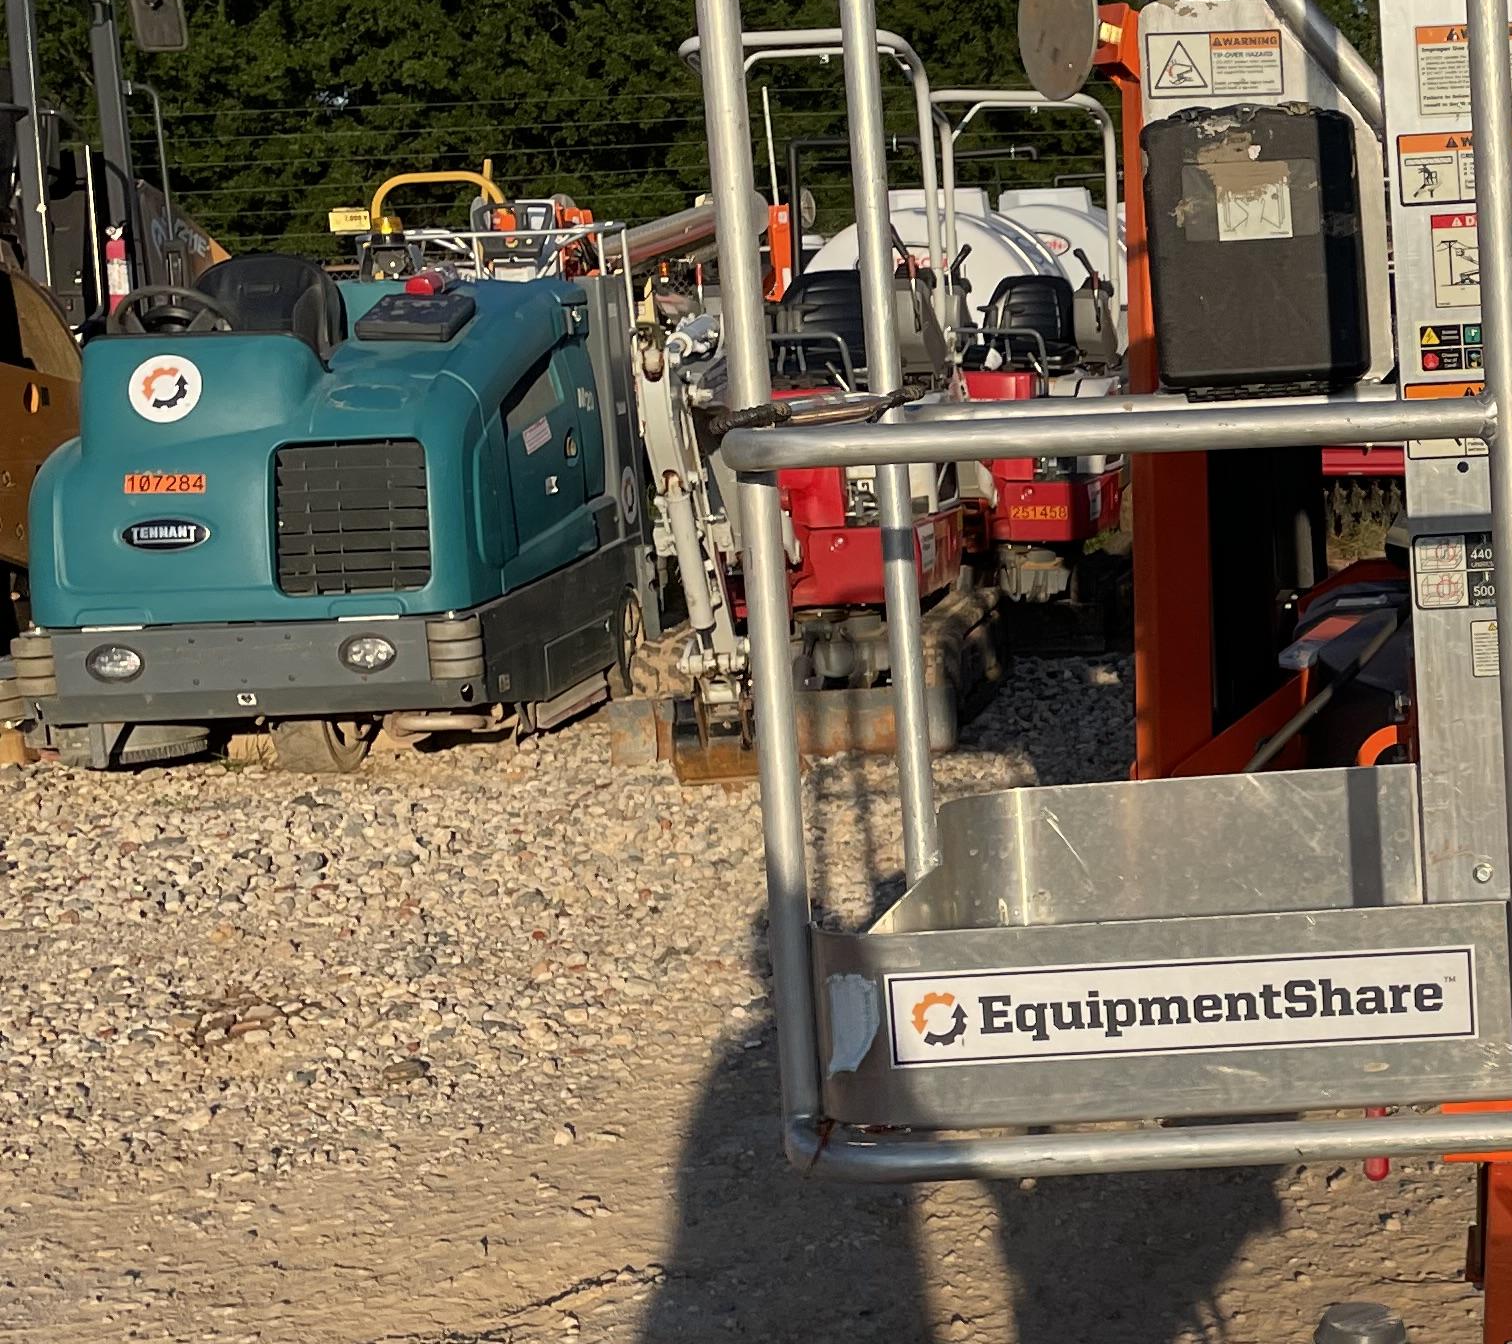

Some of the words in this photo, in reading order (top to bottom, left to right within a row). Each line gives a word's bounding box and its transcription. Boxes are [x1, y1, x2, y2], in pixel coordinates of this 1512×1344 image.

[1223, 36, 1278, 47] WARNING
[128, 475, 204, 492] 107284
[131, 525, 196, 544] TENNANT
[1470, 548, 1492, 560] 440
[1473, 585, 1495, 597] 500
[978, 978, 1444, 1042] EquipmentShare
